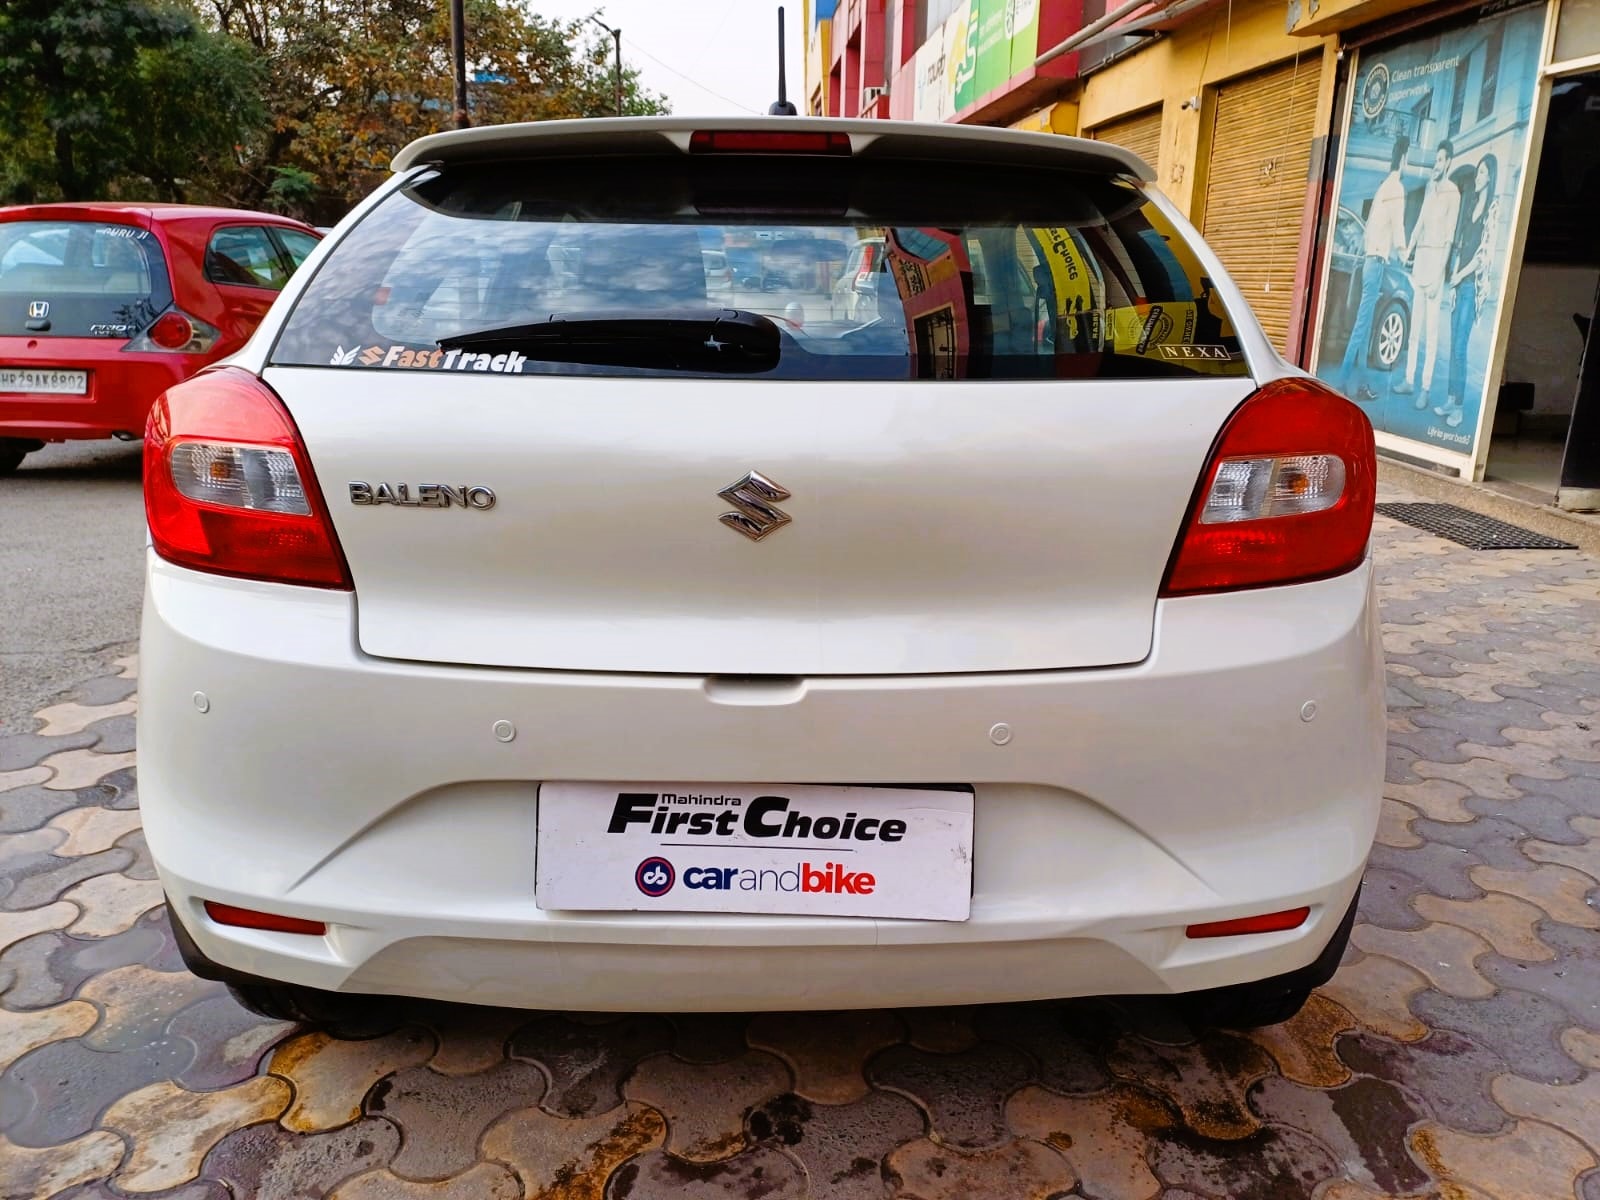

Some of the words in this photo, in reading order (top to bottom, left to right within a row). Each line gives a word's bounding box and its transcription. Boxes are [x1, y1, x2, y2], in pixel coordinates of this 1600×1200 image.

[1391, 69, 1412, 82] Clean
[1414, 55, 1460, 76] transparent
[382, 346, 527, 372] FastTrack
[1165, 345, 1225, 358] NEXA
[348, 481, 496, 511] BALENO
[661, 793, 742, 806] Mahindra
[607, 793, 739, 836] First
[743, 796, 907, 842] Choice
[683, 863, 876, 895] carandbike
